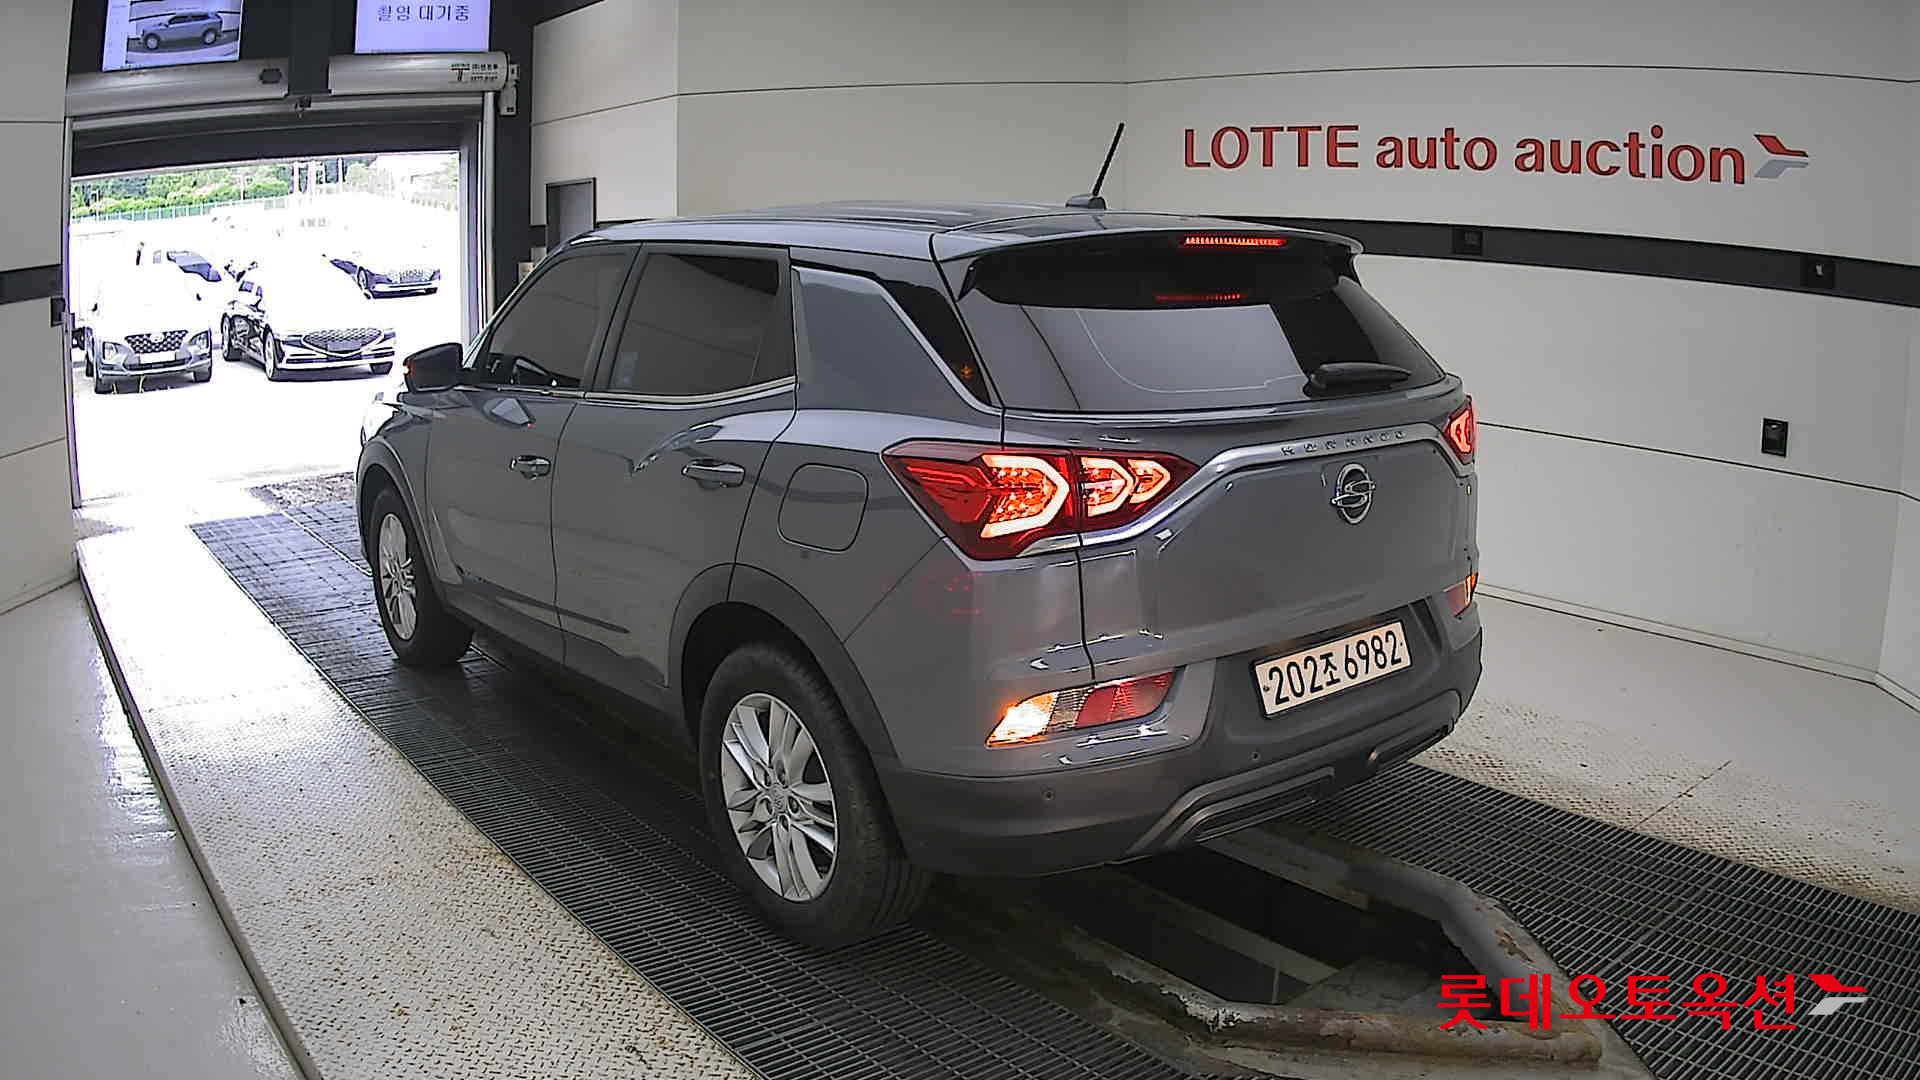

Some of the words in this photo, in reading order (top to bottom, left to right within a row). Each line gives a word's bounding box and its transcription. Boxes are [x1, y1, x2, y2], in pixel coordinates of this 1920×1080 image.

[419, 5, 469, 21] 대기중
[1184, 125, 1360, 169] LOTTE
[1376, 127, 1498, 171] auto
[1514, 125, 1746, 185] auction
